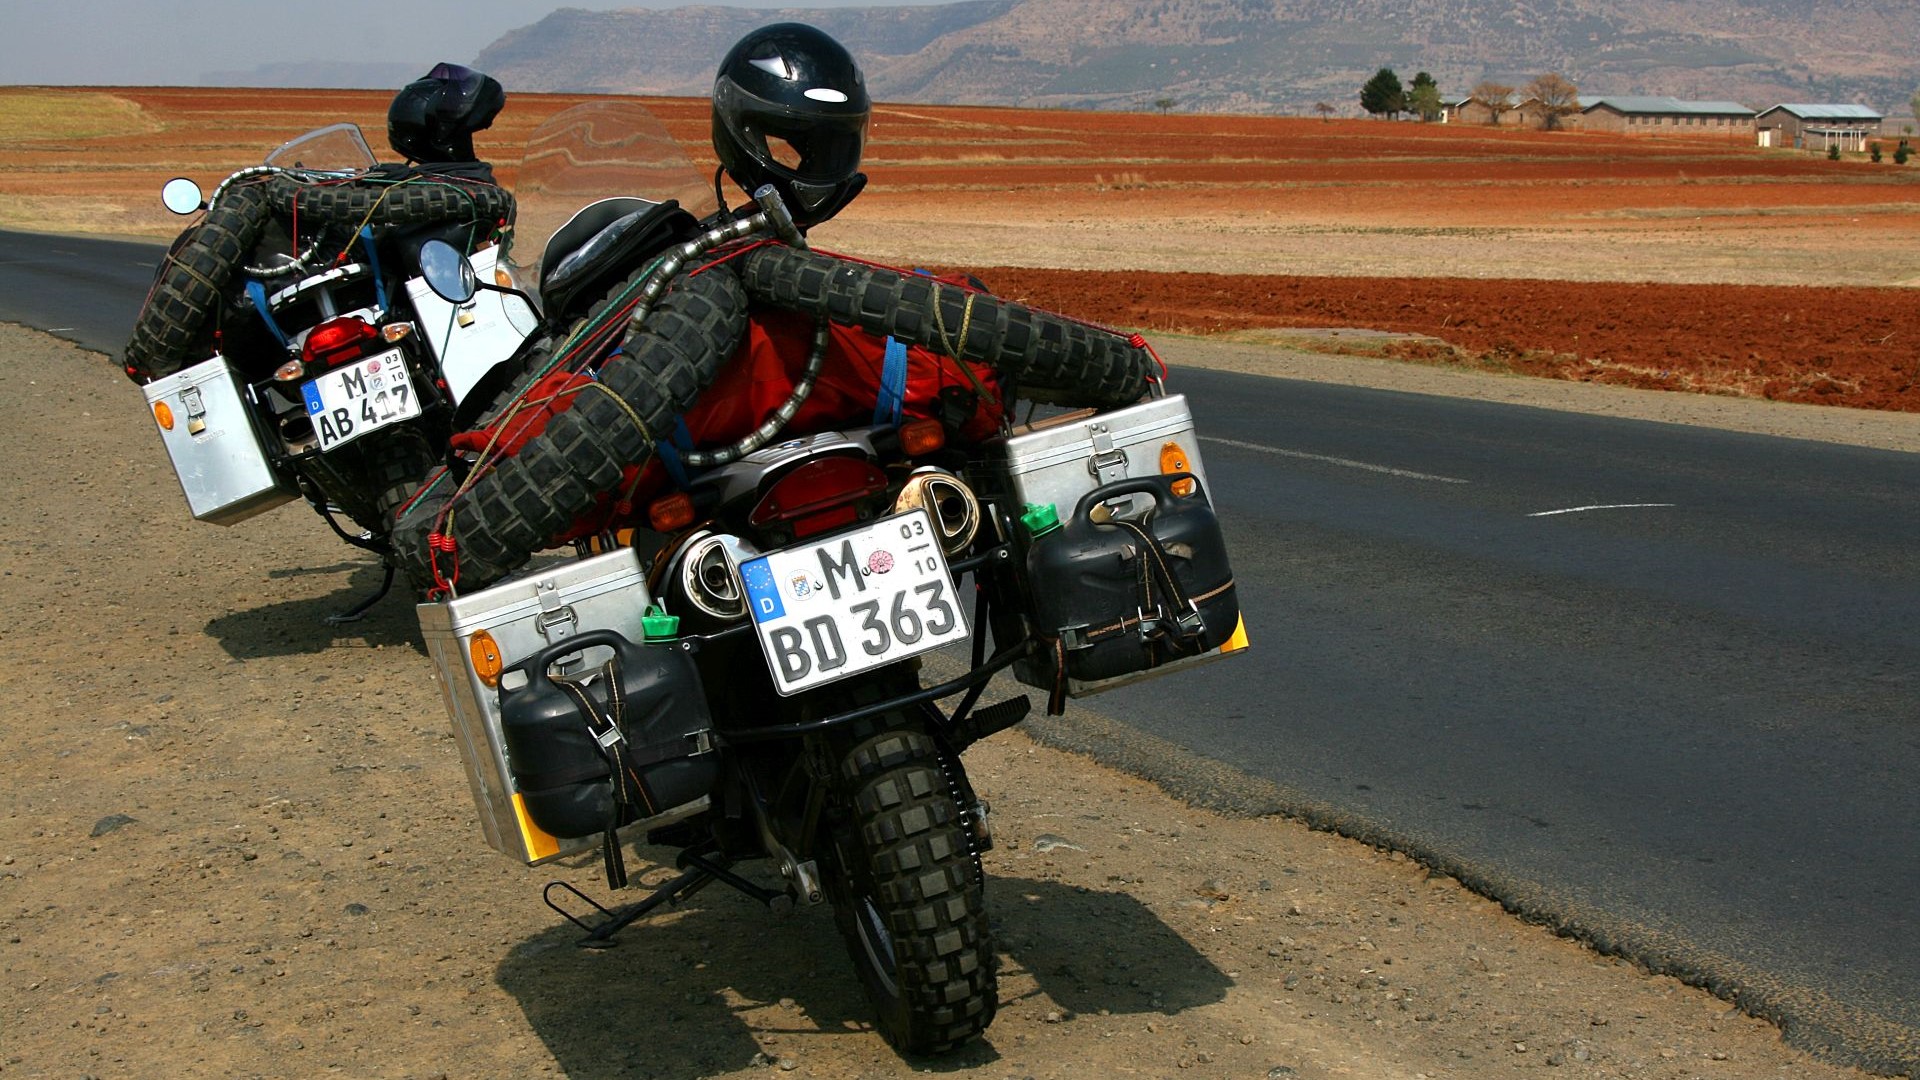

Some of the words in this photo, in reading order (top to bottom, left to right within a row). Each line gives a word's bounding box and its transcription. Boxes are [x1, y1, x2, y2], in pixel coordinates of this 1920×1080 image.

[385, 353, 399, 365] 03
[341, 367, 367, 400] M
[391, 371, 404, 382] 10
[311, 401, 320, 411] D
[319, 407, 354, 446] AB
[899, 520, 925, 540] 03
[816, 539, 866, 600] M
[914, 556, 937, 575] 10
[759, 597, 775, 614] D
[769, 614, 847, 684] BD
[850, 579, 955, 656] 363
